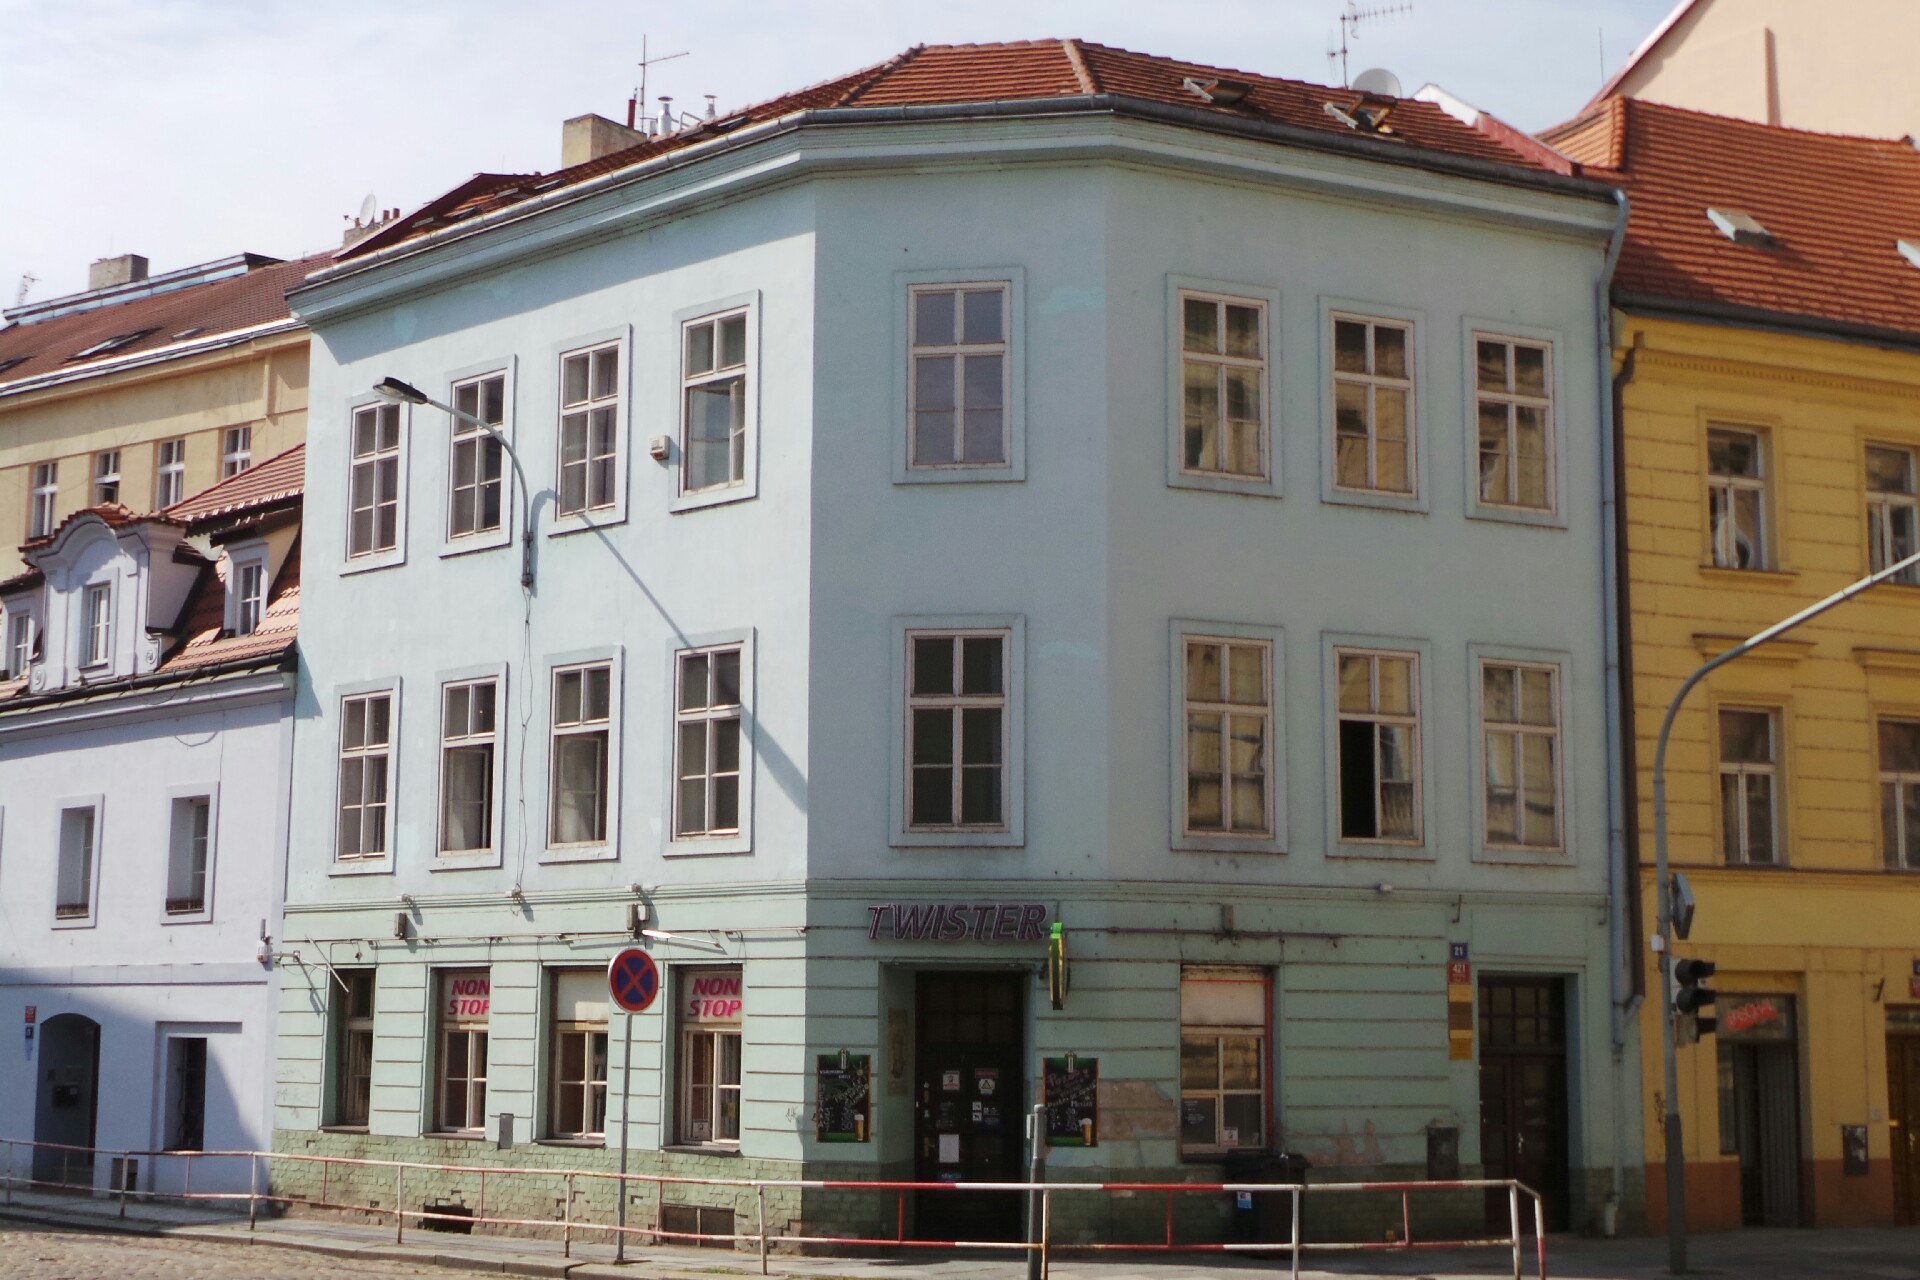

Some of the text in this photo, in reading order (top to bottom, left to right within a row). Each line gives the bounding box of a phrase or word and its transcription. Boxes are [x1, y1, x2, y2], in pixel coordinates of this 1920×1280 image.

[867, 903, 1048, 940] TWISTER
[451, 979, 490, 996] NON
[691, 977, 742, 996] NON
[687, 999, 742, 1018] STOP
